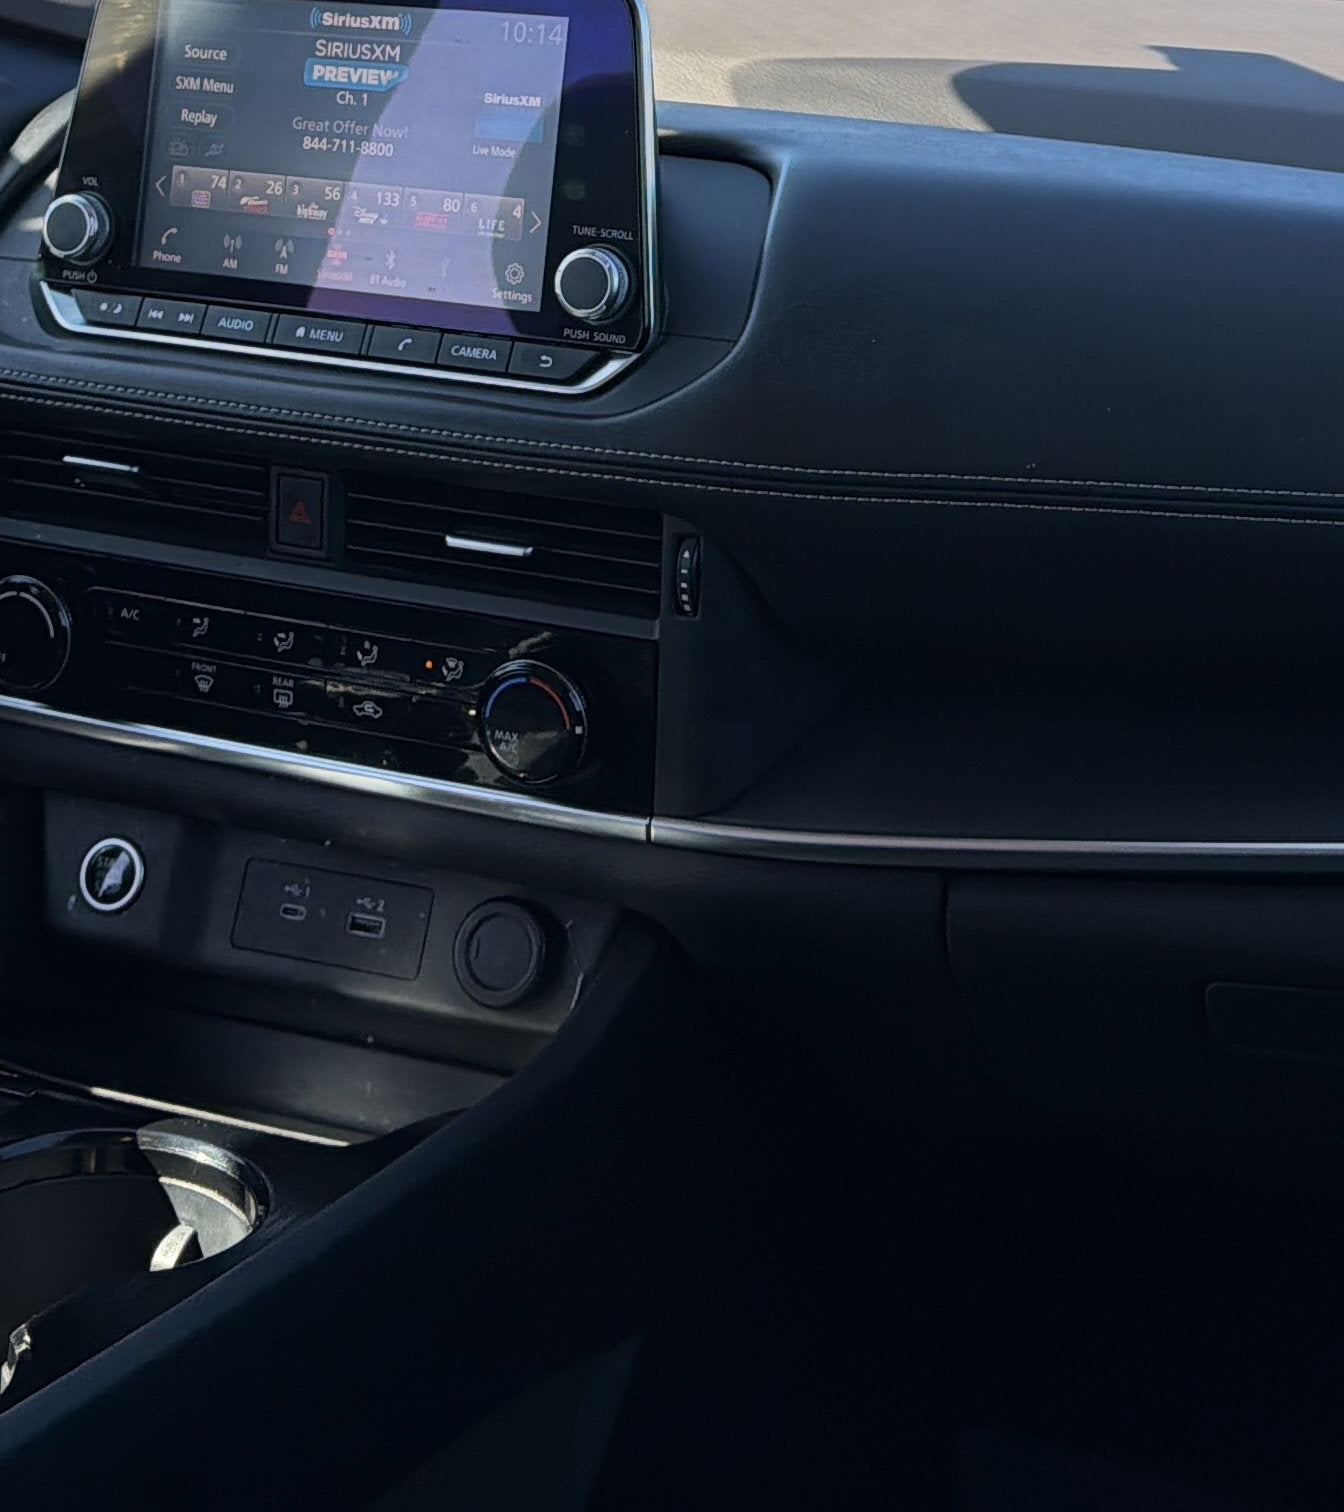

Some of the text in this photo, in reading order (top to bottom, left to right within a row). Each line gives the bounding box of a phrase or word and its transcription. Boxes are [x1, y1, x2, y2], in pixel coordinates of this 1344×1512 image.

[502, 20, 563, 46] 10:14
[184, 45, 228, 61] Source
[314, 39, 401, 62] SIRIUSXM
[312, 64, 400, 85] PREVIEW
[176, 75, 234, 94] SXM Menu
[336, 91, 368, 106] Ch. 1
[484, 92, 541, 107] SiriusXM
[181, 108, 218, 128] Replay
[292, 116, 408, 139] Great Offer Now!
[303, 136, 394, 157] 844-711-8800
[473, 145, 516, 158] Live Mode
[83, 176, 98, 187] VOL
[211, 174, 227, 189] 74
[235, 178, 283, 195] 2 26
[292, 184, 341, 201] 3 56
[377, 191, 400, 207] 133
[410, 196, 461, 213] 5 80
[470, 202, 522, 219] 6 4
[478, 218, 505, 232] LIFE
[153, 250, 182, 264] Phone
[222, 257, 237, 269] AM
[62, 269, 85, 281] PUSH
[275, 264, 288, 275] FM
[369, 274, 407, 289] BT Audio
[492, 287, 533, 303] Settings
[218, 316, 254, 332] AUDIO
[309, 328, 344, 343] MENU
[563, 327, 626, 345] PUSH SOUND
[451, 345, 497, 361] CAMERA
[121, 607, 140, 622] A/C
[191, 662, 217, 674] FRONT
[272, 676, 294, 689] REAR
[494, 729, 518, 741] MAX
[499, 741, 518, 754] A/C
[377, 899, 385, 912] 2
